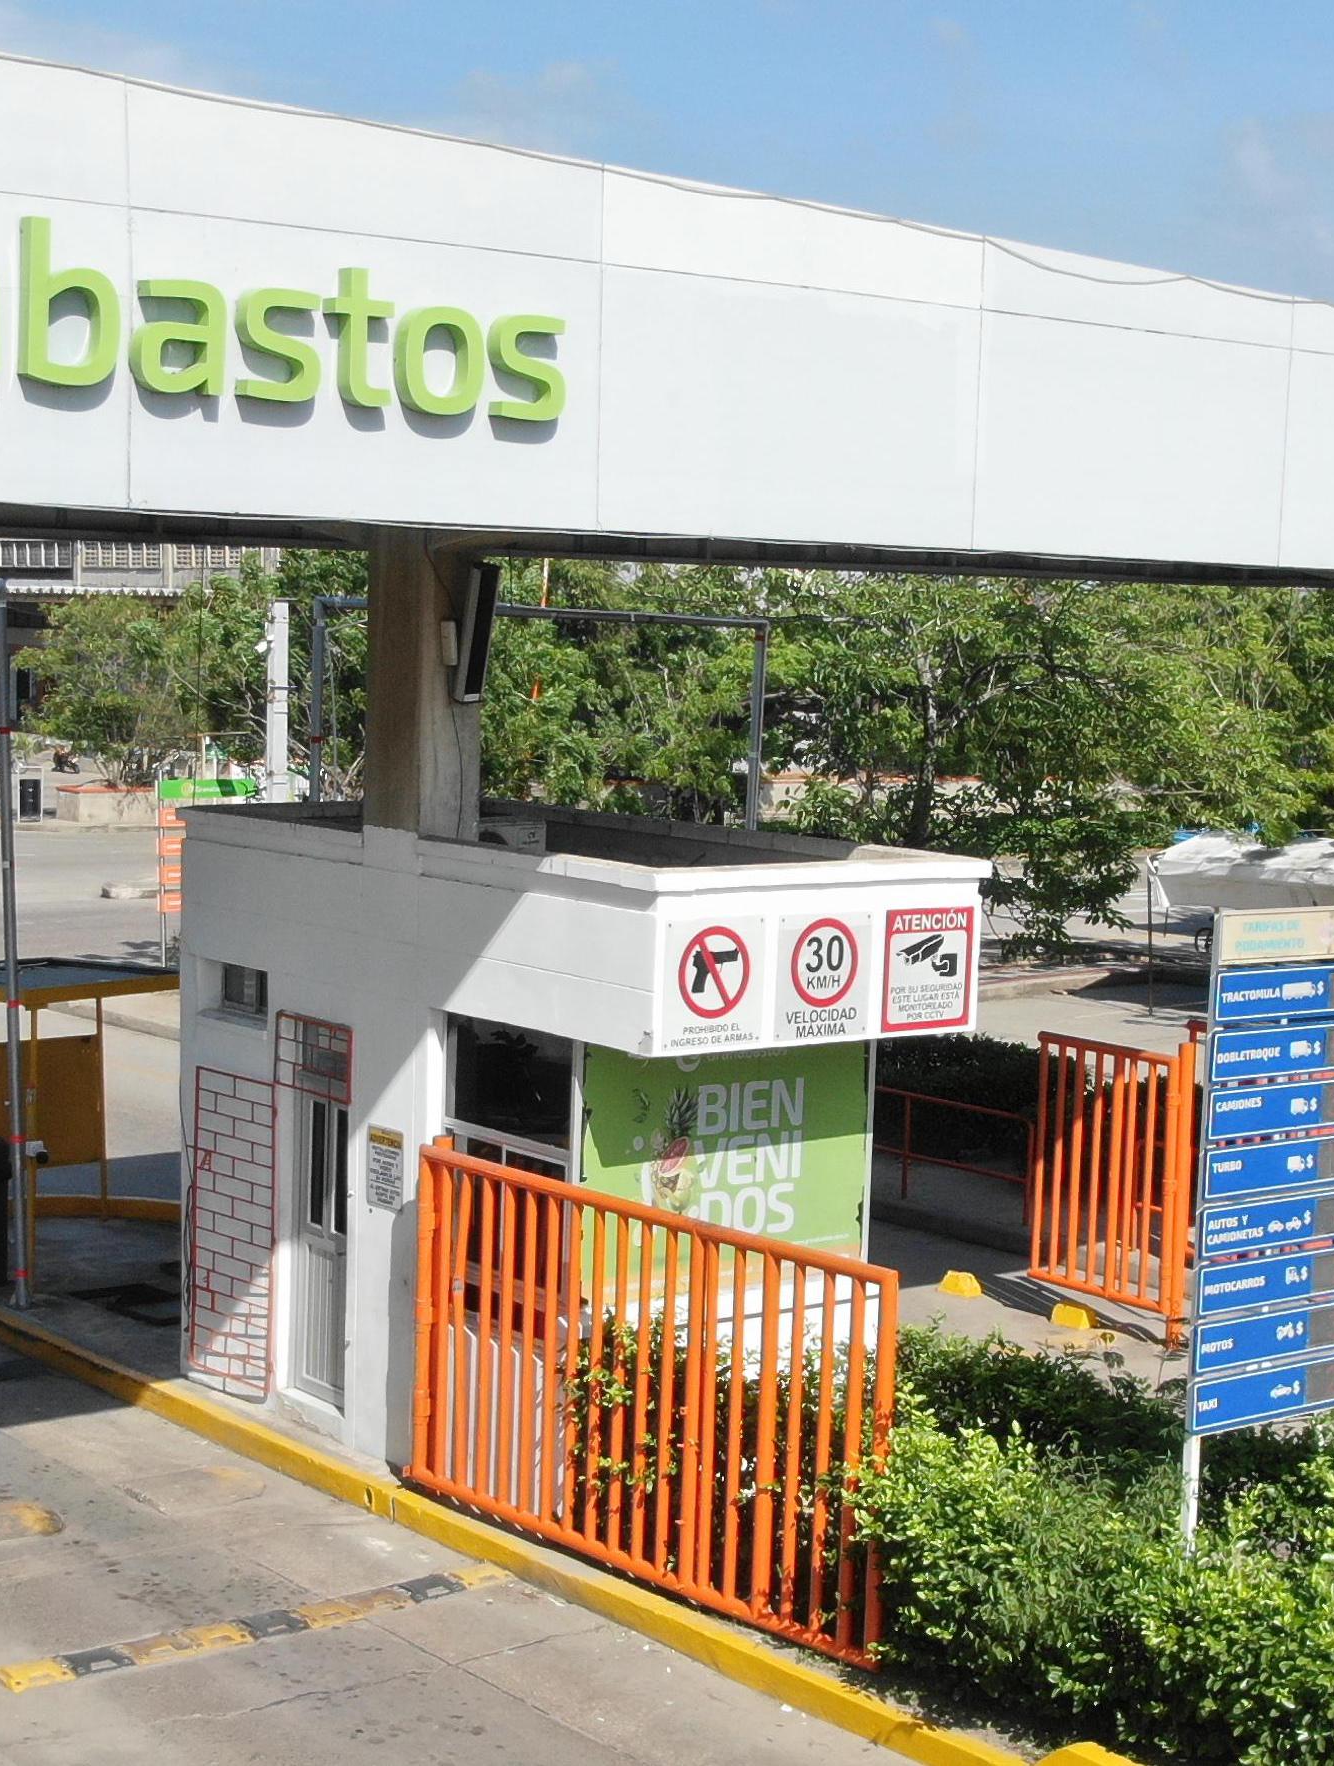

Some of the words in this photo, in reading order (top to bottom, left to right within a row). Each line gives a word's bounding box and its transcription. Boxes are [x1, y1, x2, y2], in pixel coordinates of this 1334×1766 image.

[892, 909, 968, 931] ATENCIÓN
[805, 935, 844, 973] 30
[806, 974, 841, 990] KM/H
[891, 986, 906, 995] POR
[908, 985, 919, 994] SU
[920, 982, 963, 993] SEGURIDAD
[1221, 988, 1281, 1003] TRACTOMULA
[1317, 980, 1324, 996] $
[892, 995, 912, 1005] ESTE
[913, 993, 940, 1003] LUGAR
[898, 1001, 953, 1012] MONITOREADO
[786, 1007, 858, 1025] VELOCIDAD
[907, 1012, 923, 1020] POR
[924, 1010, 945, 1019] CCTV
[683, 1023, 729, 1035] PROHIBIDO
[731, 1022, 741, 1032] EL
[670, 1035, 709, 1047] INGRESO
[711, 1034, 722, 1044] DE
[725, 1032, 754, 1042] ARMAS
[1217, 1046, 1281, 1064] DOBLETROQUE
[1313, 1040, 1321, 1055] $
[697, 1077, 805, 1136] BIEN
[1216, 1096, 1262, 1113] CAMIONES
[1310, 1097, 1317, 1112] $
[694, 1130, 802, 1189] VENI
[1212, 1160, 1243, 1174] TURBO
[1306, 1154, 1314, 1169] $
[697, 1182, 795, 1235] DOS
[1207, 1227, 1264, 1245] CAMIONETAS
[1304, 1210, 1311, 1225] $
[1208, 1217, 1238, 1231] AUTOS
[1242, 1215, 1249, 1226] Y
[1204, 1276, 1266, 1296] MOTOCARROS
[1301, 1266, 1308, 1281] $
[1201, 1338, 1234, 1354] MOTOS
[1296, 1321, 1304, 1336] $
[1197, 1398, 1218, 1412] TAXI
[1293, 1380, 1300, 1395] $
